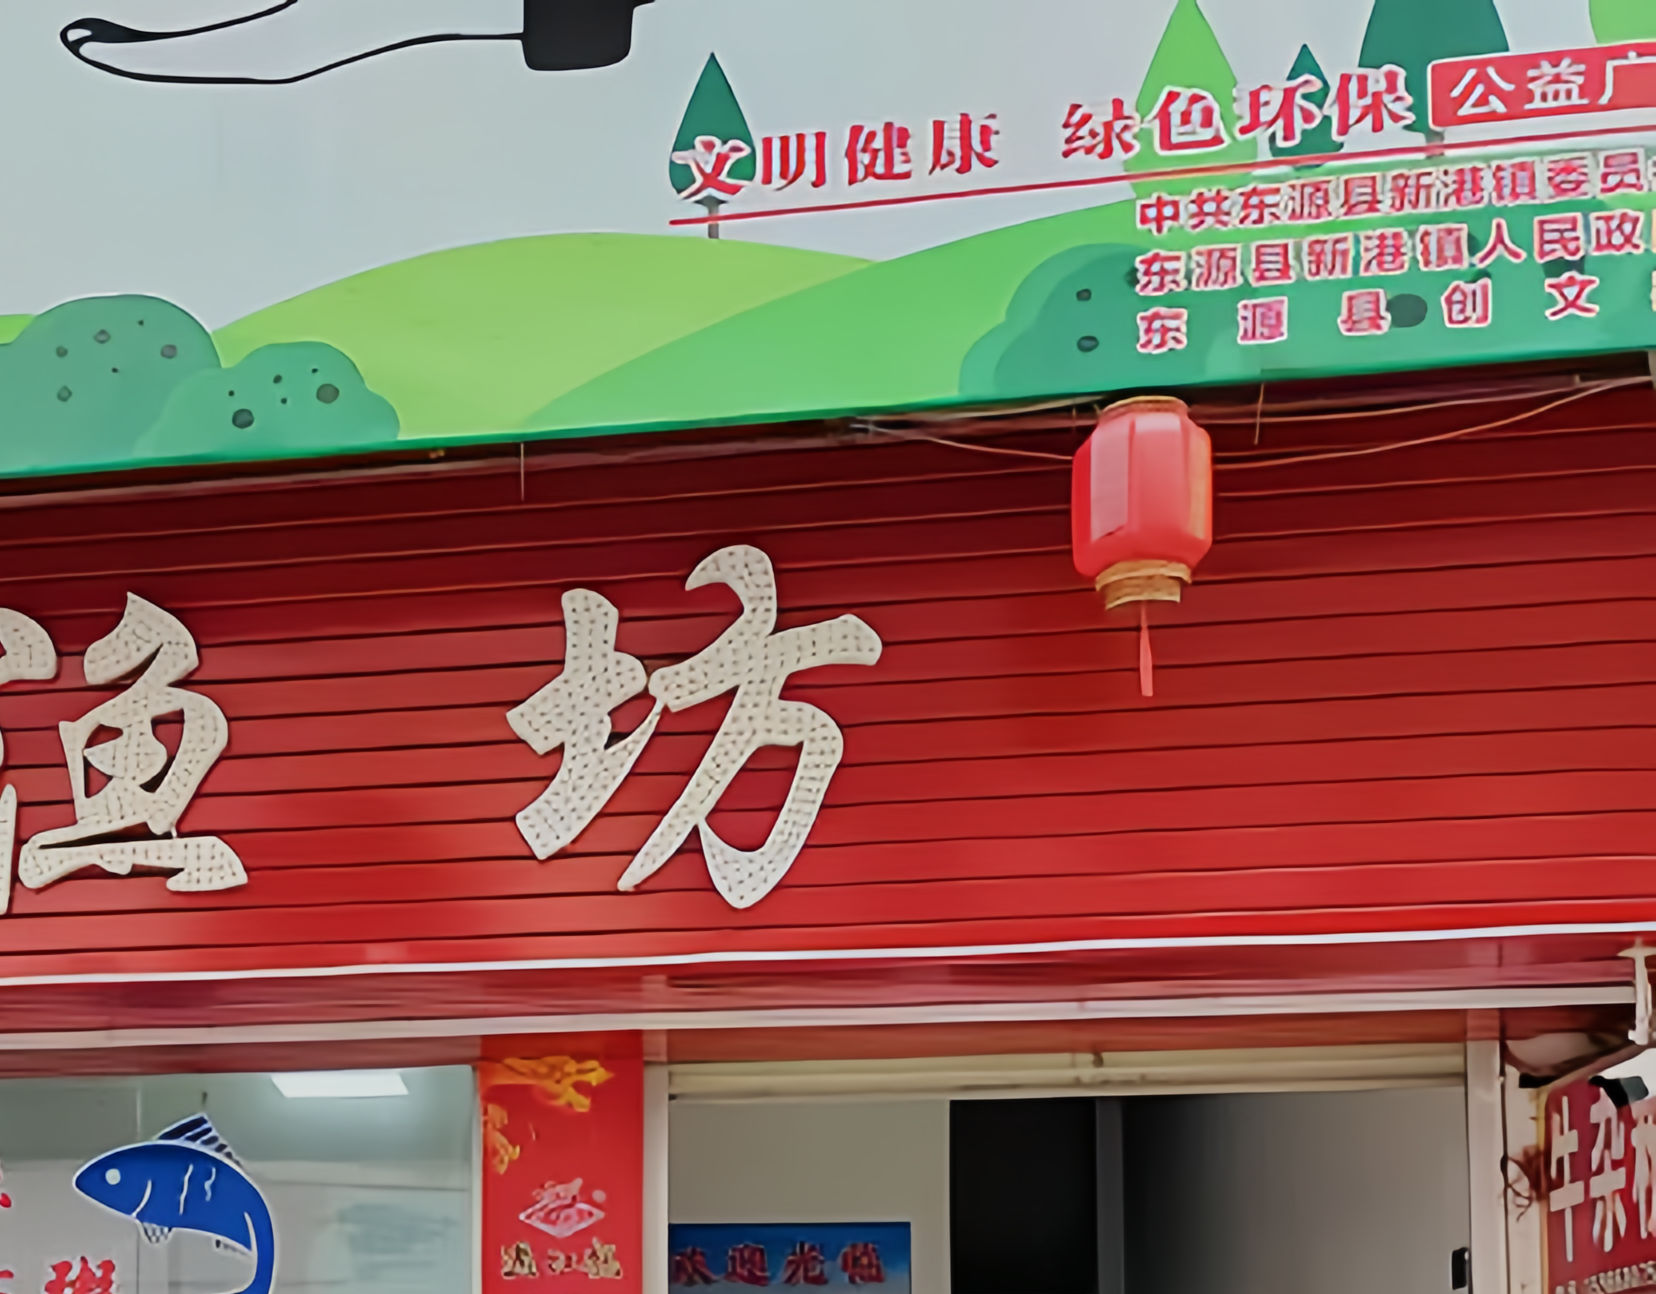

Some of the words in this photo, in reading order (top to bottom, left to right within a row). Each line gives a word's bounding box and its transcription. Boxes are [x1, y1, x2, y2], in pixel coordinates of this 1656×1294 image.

[672, 112, 1001, 199] 文明健康
[1061, 65, 1415, 162] 绿色环保
[1137, 148, 1656, 235] 中共东源县新港镇委员
[1136, 209, 1656, 296] 东源县新港镇人民政
[1137, 270, 1656, 354] 东源县创文
